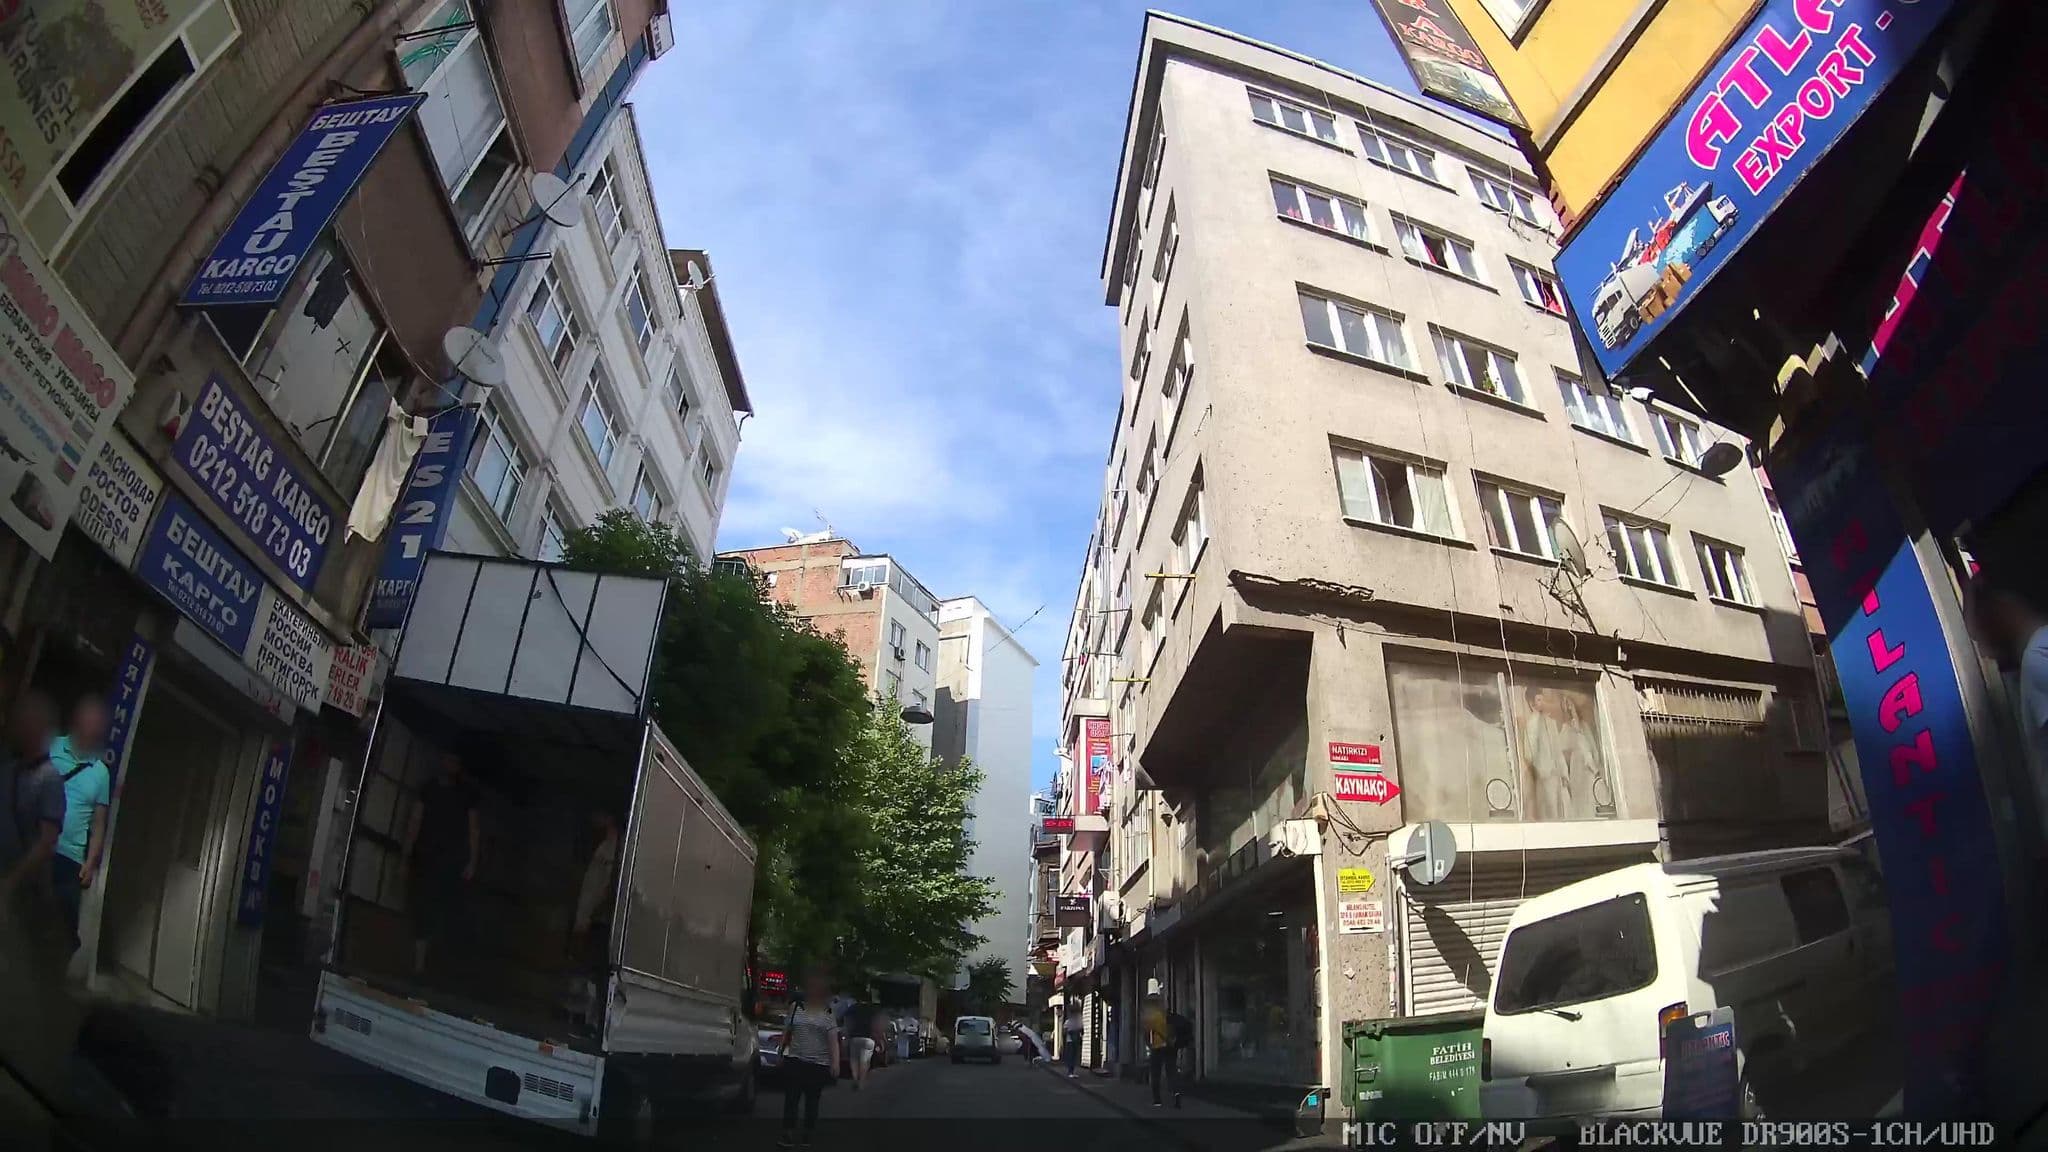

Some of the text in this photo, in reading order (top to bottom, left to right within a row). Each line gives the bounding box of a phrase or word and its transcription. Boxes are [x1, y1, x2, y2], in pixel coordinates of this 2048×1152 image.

[310, 105, 407, 131] БЕШТАУ
[1733, 24, 1876, 196] EXPORT
[201, 254, 296, 280] KARGO
[200, 382, 330, 546] BEŞTAĞ KARGO
[87, 460, 140, 523] РОСТОВ
[189, 434, 312, 579] 0212 518 73 03
[166, 512, 257, 604] БЕШТАУ
[162, 552, 239, 626] КАРГО
[263, 627, 314, 677] МОСКВА
[268, 611, 312, 655] РОССИИ
[258, 644, 320, 700] ПЯТИГОРСК
[1335, 776, 1387, 800] KAYNAKÇI
[1430, 1048, 1475, 1065] BELEDİYESİ
[1432, 1042, 1472, 1056] FATİH
